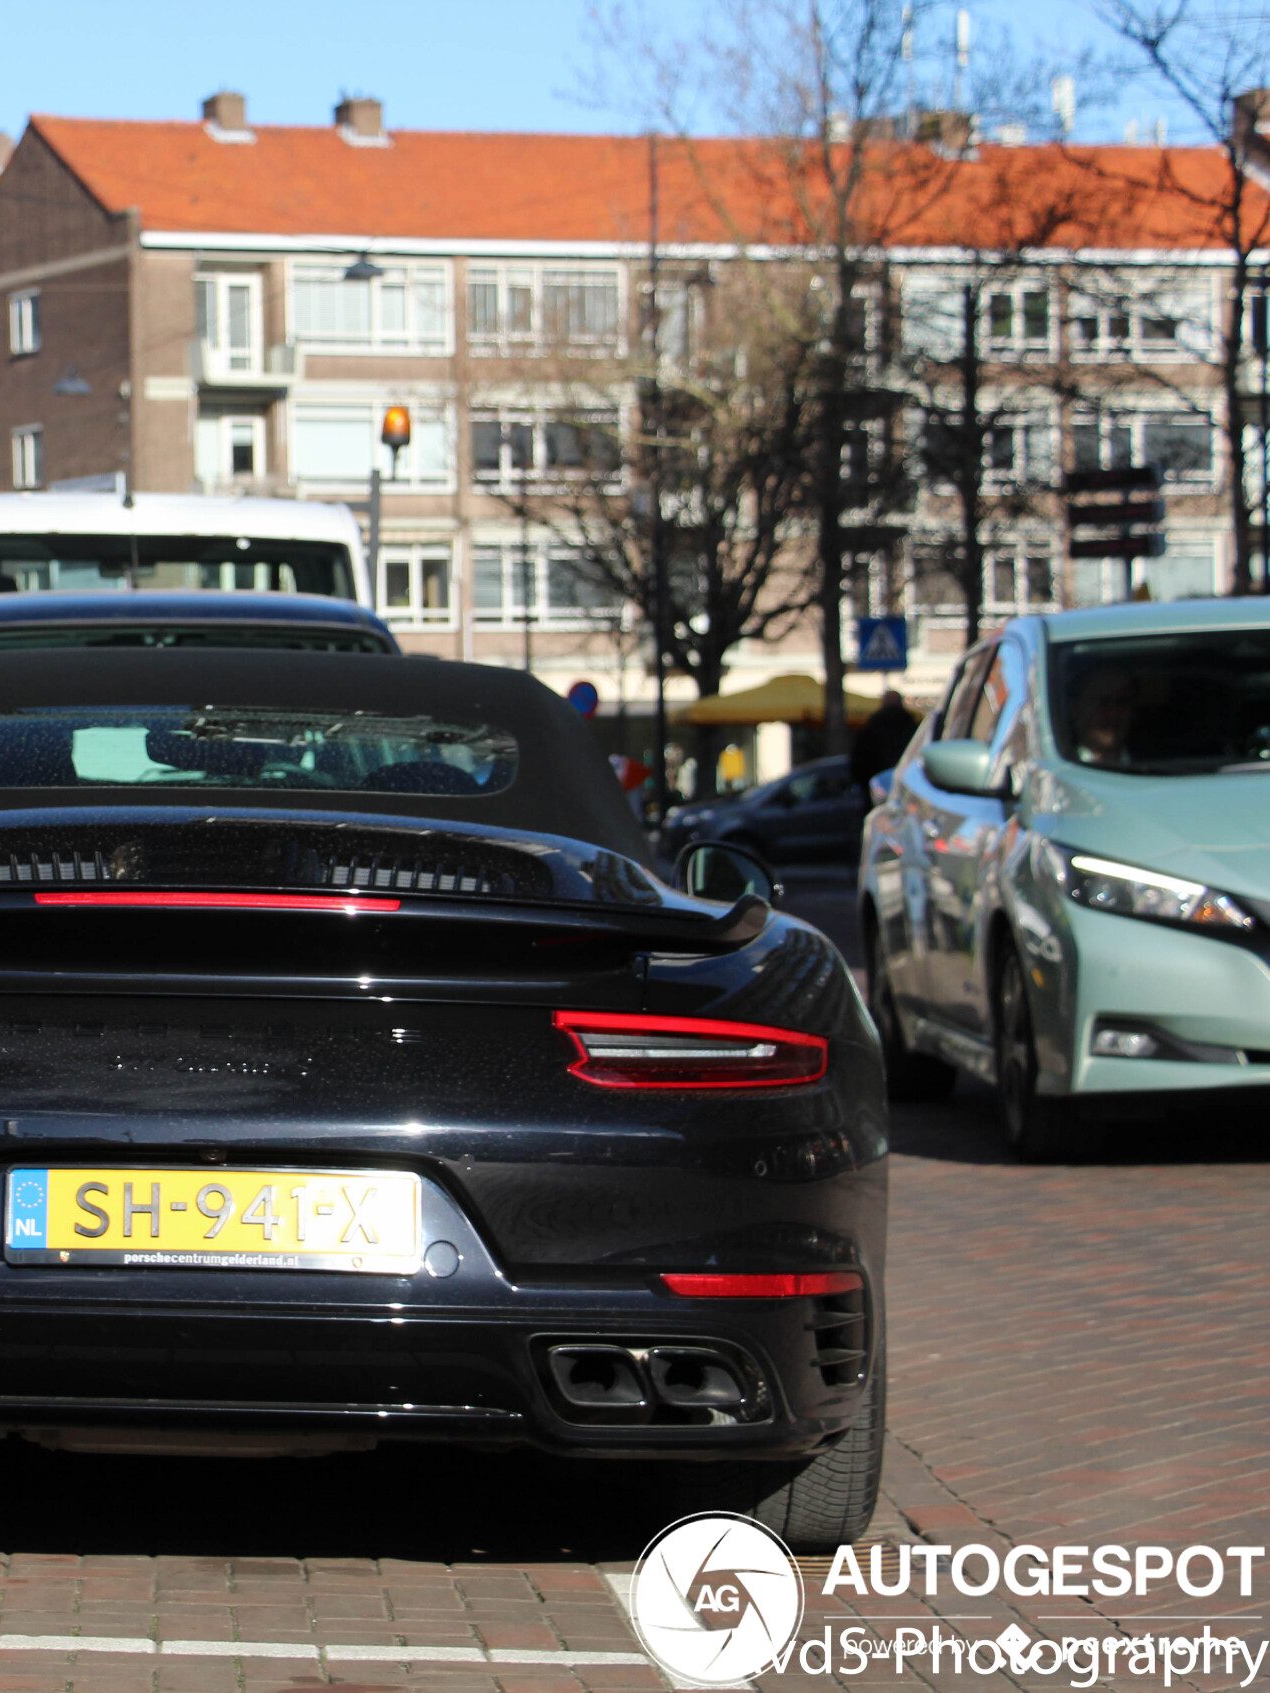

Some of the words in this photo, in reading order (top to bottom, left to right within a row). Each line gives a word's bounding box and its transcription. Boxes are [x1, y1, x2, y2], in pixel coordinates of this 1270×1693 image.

[74, 1181, 380, 1244] SH-941-X
[16, 1219, 42, 1237] NL
[124, 1252, 299, 1267] porschecentrumgelderland.nl
